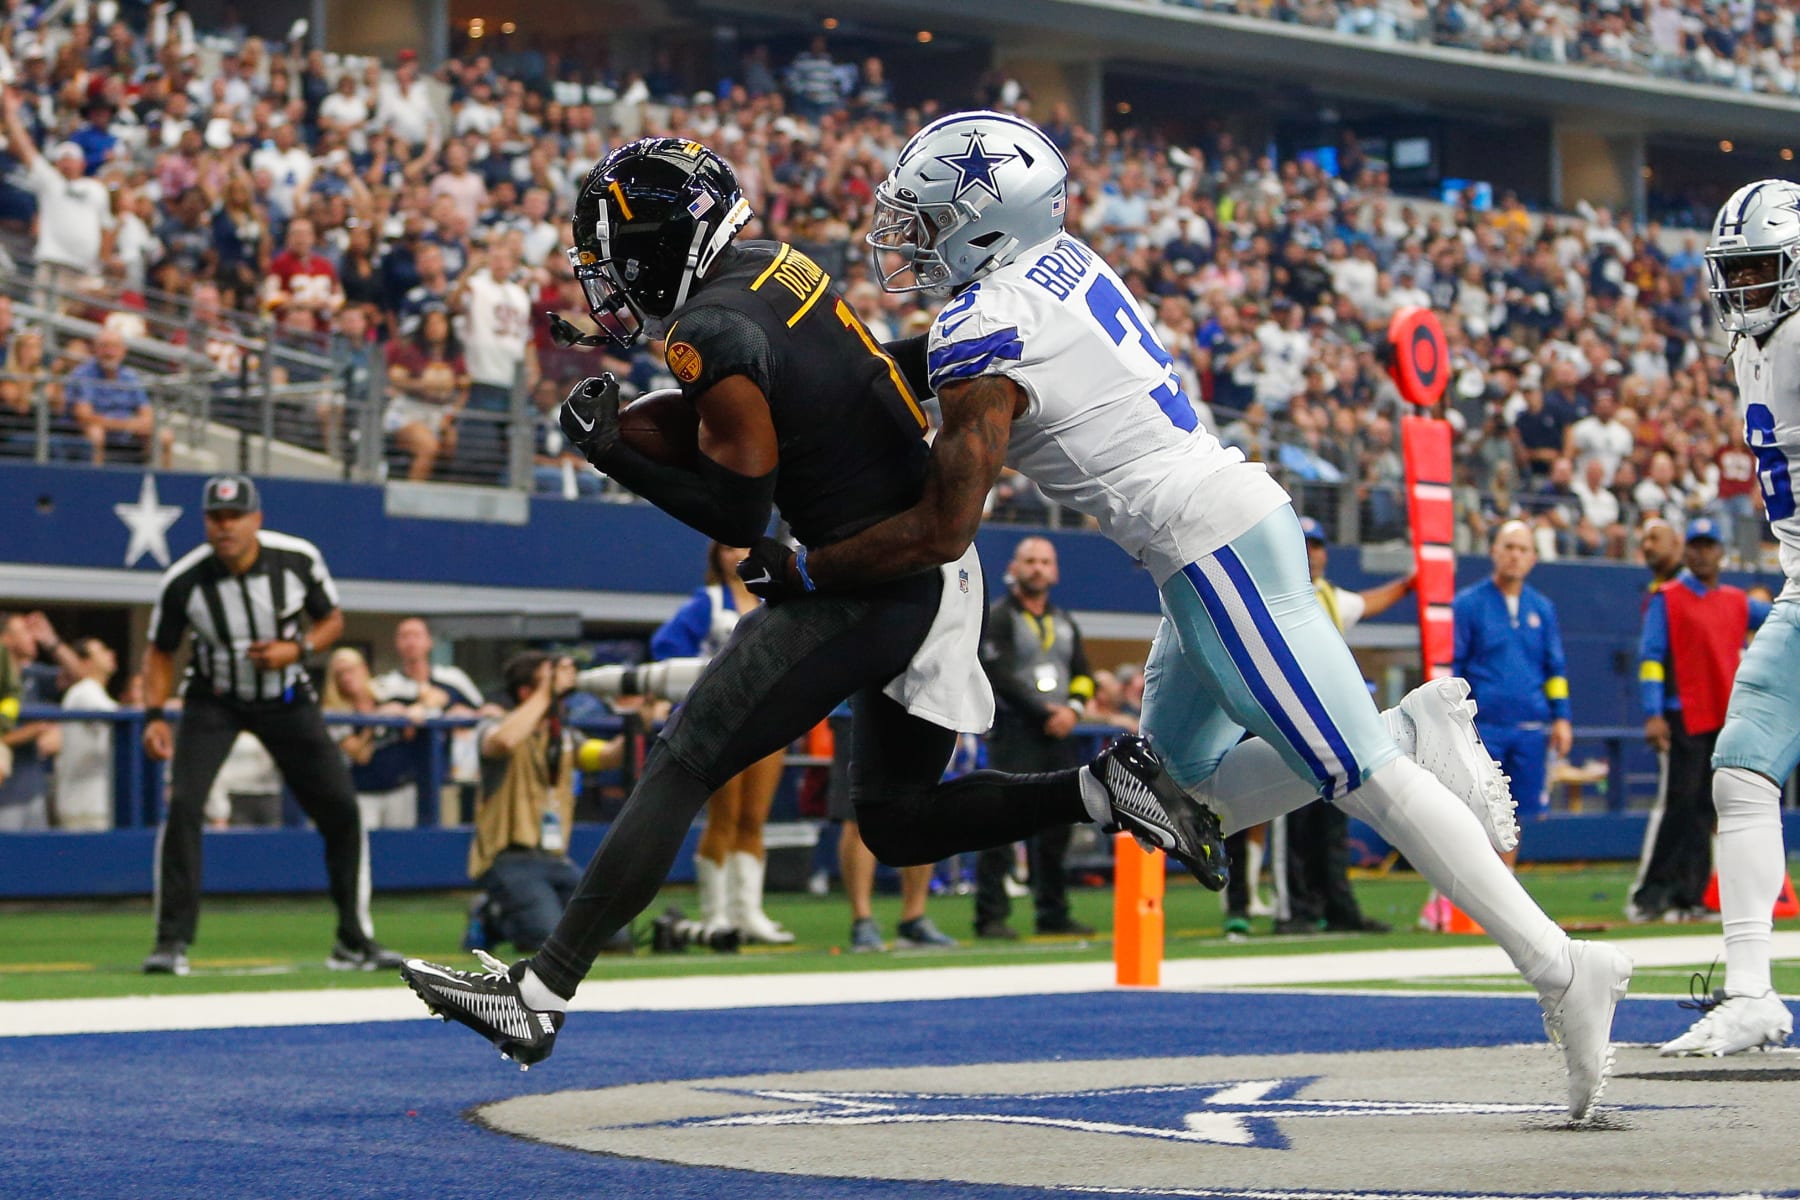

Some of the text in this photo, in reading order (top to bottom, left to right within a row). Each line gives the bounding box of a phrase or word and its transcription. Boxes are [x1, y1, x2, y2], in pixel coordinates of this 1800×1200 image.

[608, 181, 634, 221] 1
[834, 296, 928, 430] 1
[536, 1012, 555, 1033] NIKE
